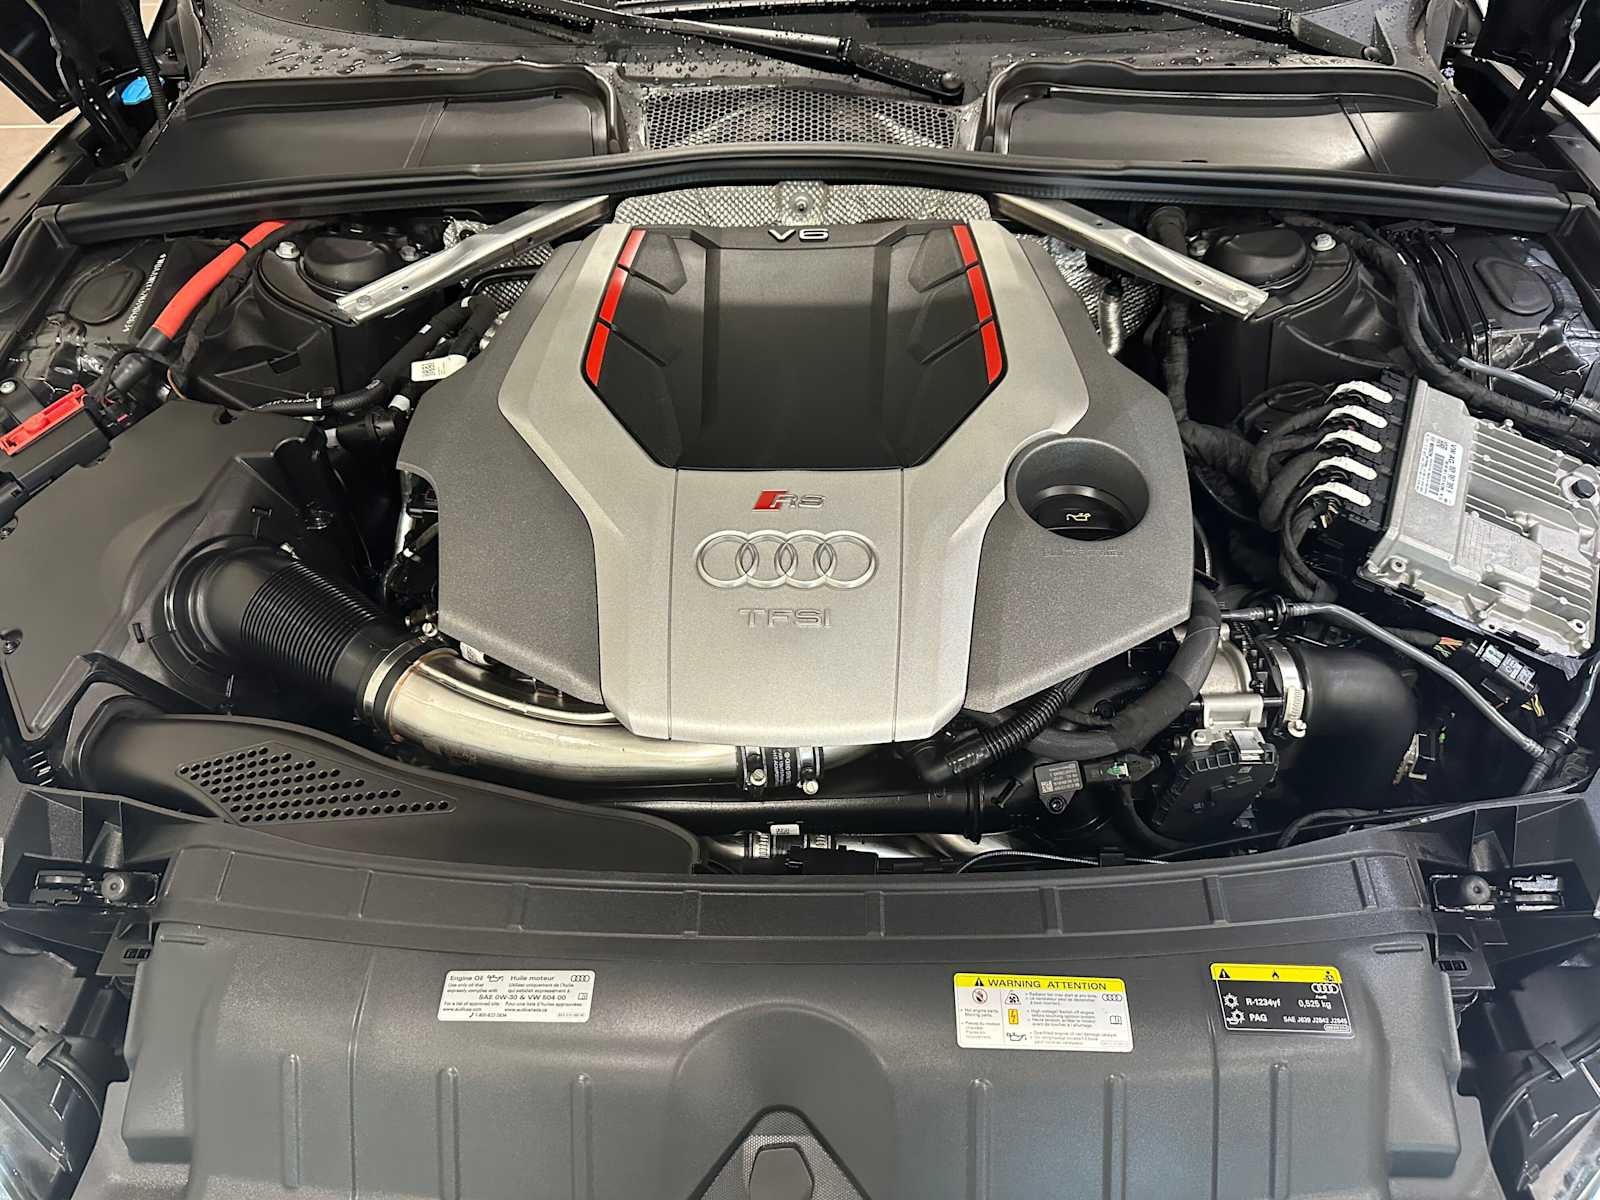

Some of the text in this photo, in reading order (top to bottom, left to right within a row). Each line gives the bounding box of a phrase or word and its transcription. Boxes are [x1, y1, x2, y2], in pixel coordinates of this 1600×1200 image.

[768, 228, 829, 242] V6
[766, 493, 826, 509] RS
[738, 608, 832, 628] TFSI
[987, 979, 1041, 988] WARNING
[1047, 980, 1107, 990] ATTENTION
[1245, 997, 1281, 1008] R-1234yf
[1298, 999, 1332, 1010] 0,525 kg
[1249, 1014, 1268, 1022] PAG
